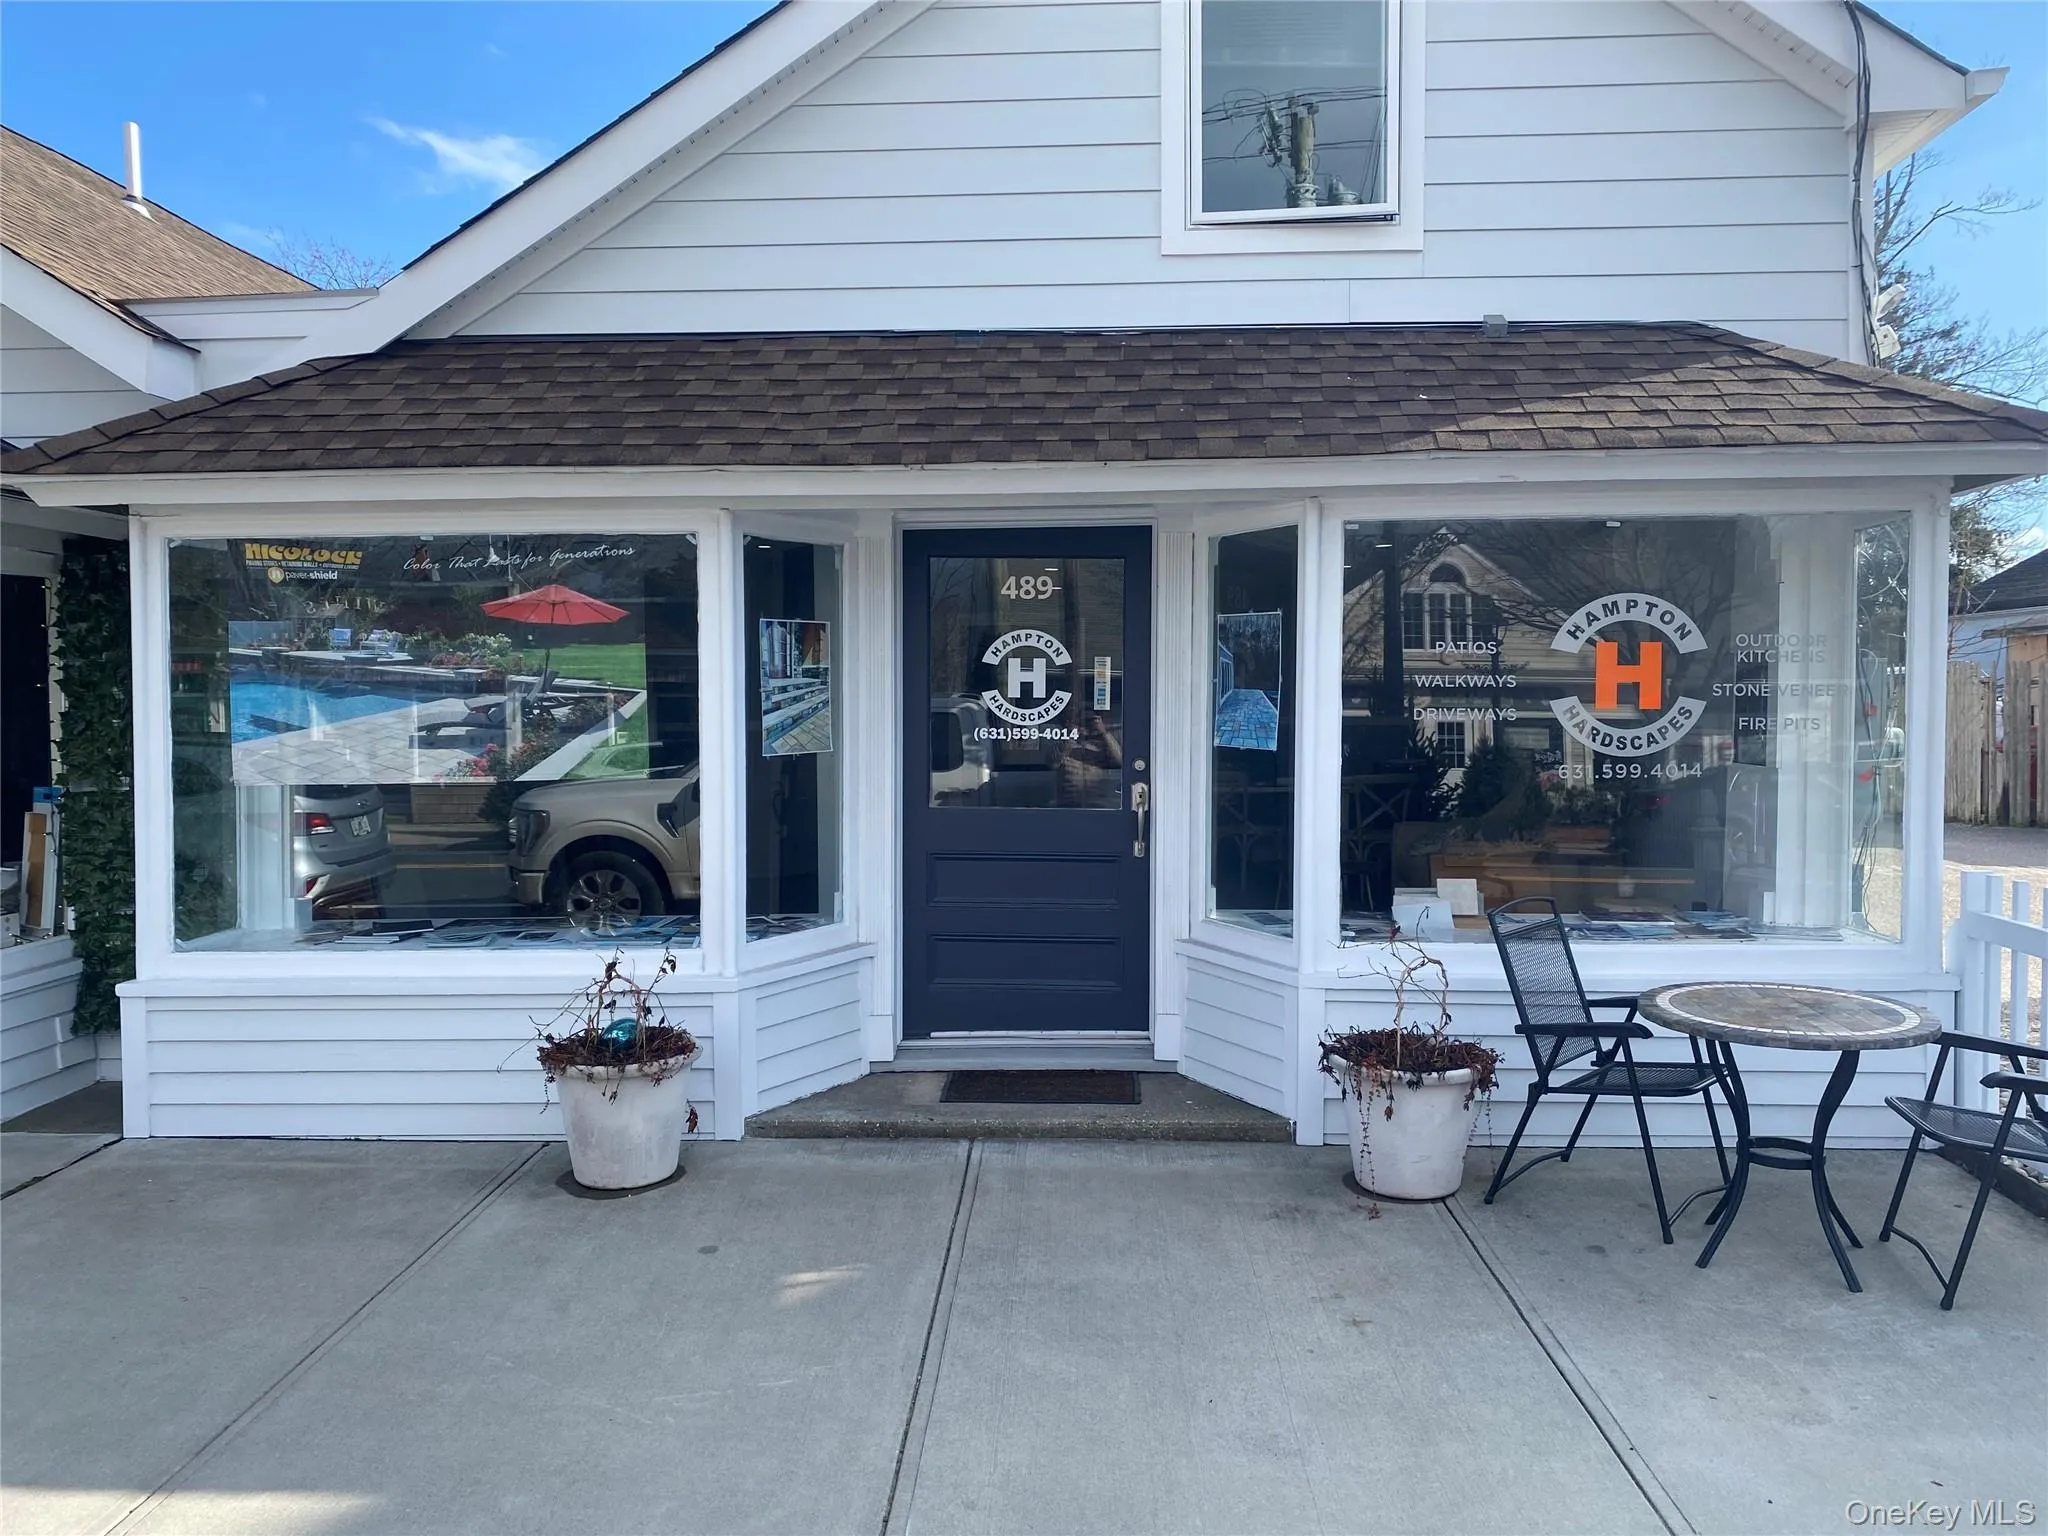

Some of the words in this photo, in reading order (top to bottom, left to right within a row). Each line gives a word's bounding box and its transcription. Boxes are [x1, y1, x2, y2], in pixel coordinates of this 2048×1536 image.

[245, 543, 362, 564] NICOLOCK
[403, 558, 440, 570] Color
[449, 556, 483, 569] That
[521, 552, 543, 569] for
[550, 544, 636, 566] Generations
[285, 570, 338, 581] paver-shield
[1000, 575, 1053, 600] 489
[1566, 599, 1692, 641] HAMPTON
[991, 633, 1064, 658] HAMPTON
[1435, 641, 1497, 654] PATIOS
[1735, 633, 1827, 647] OUTDOOR
[1737, 650, 1825, 663] KITCHENS
[1008, 658, 1046, 698] H
[1414, 675, 1517, 688] WALKWAYS
[1595, 641, 1663, 710] H
[1712, 683, 1771, 697] STONE
[1777, 683, 1849, 697] VENEER
[989, 694, 1064, 722] HARDSCAPES
[1413, 708, 1517, 721] DRIVEWAYS
[1563, 704, 1693, 750] HARDSCAPES
[1738, 717, 1776, 730] FIRE
[1783, 717, 1821, 730] PITS
[973, 728, 1079, 742] (631)599-4014
[1558, 763, 1703, 779] 631.599.4014
